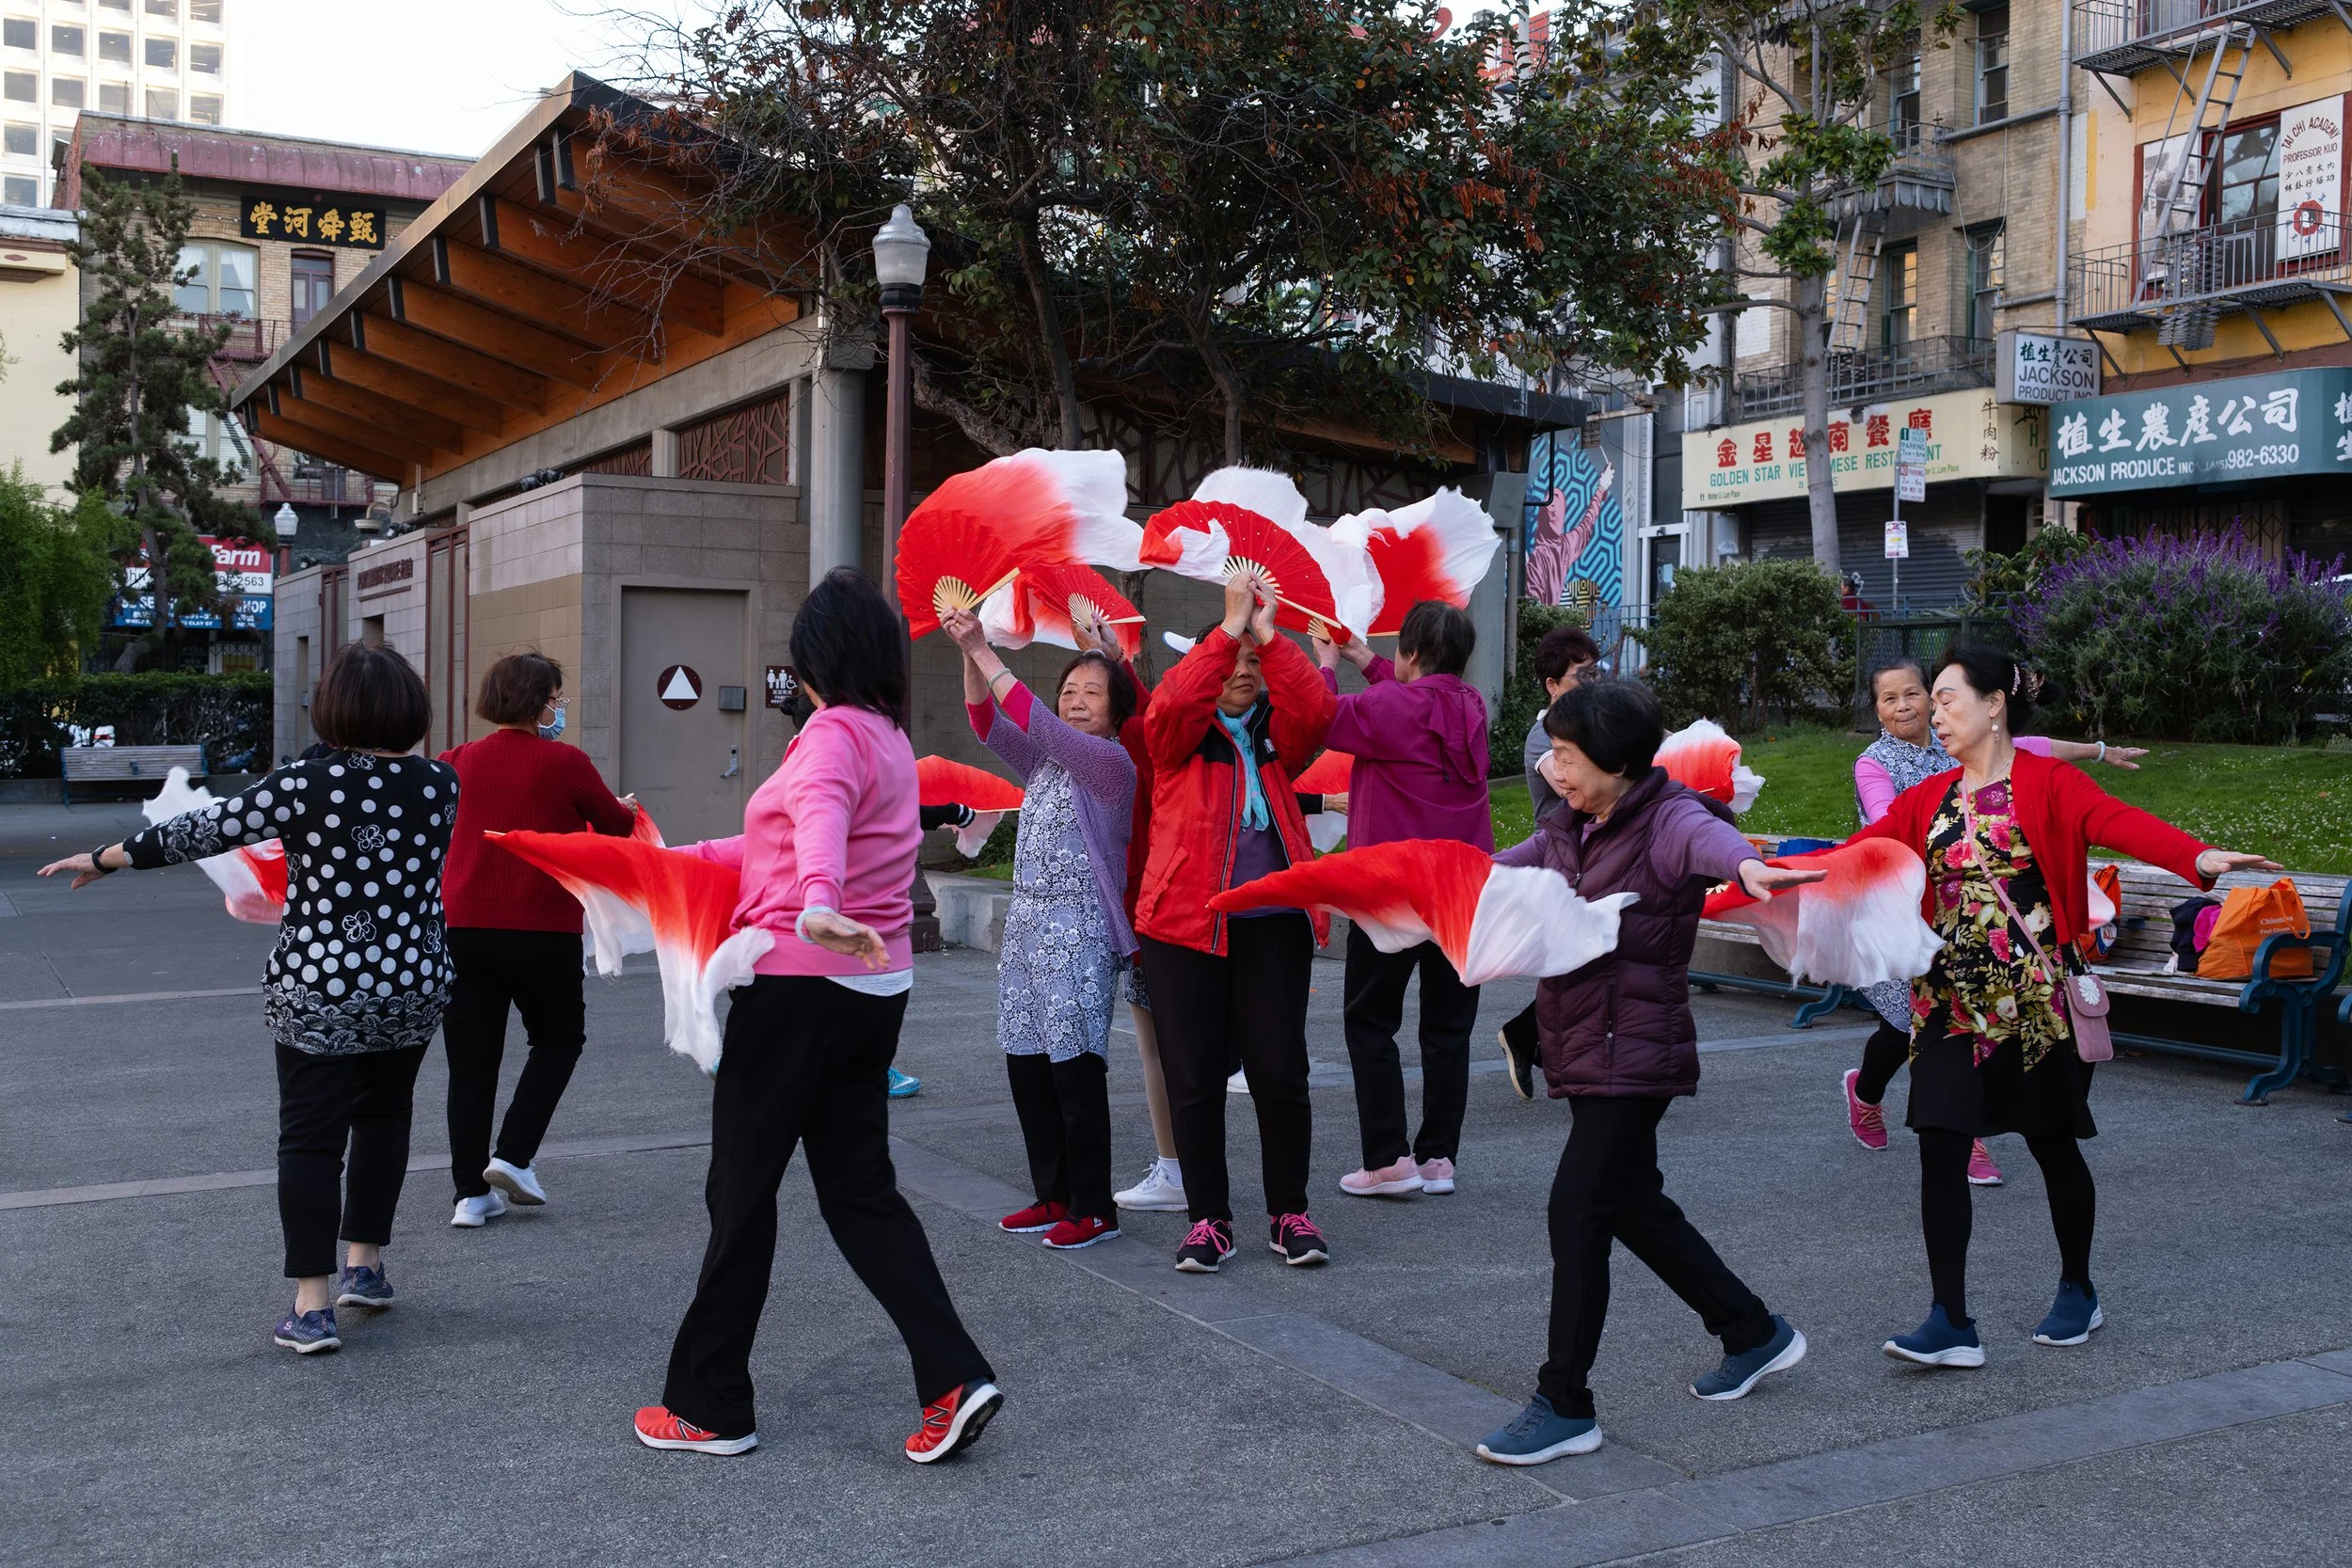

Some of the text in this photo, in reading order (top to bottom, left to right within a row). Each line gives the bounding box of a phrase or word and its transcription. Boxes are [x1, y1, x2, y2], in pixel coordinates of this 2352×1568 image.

[2281, 117, 2340, 149] TAI CHI ACADEMY
[2283, 142, 2338, 164] PROFESSOR KUO
[2019, 365, 2094, 389] JACKSON
[2018, 385, 2070, 402] PRODUCT
[1901, 441, 1925, 451] PARKING
[1710, 469, 1749, 487] GOLDEN
[1755, 465, 1781, 483] STAR
[1788, 455, 1858, 478] VIEMESE
[1866, 444, 1942, 469] RESTNT
[2051, 464, 2106, 486] JACKSON
[2110, 456, 2175, 481] PRODUCE
[211, 545, 261, 566] Farm
